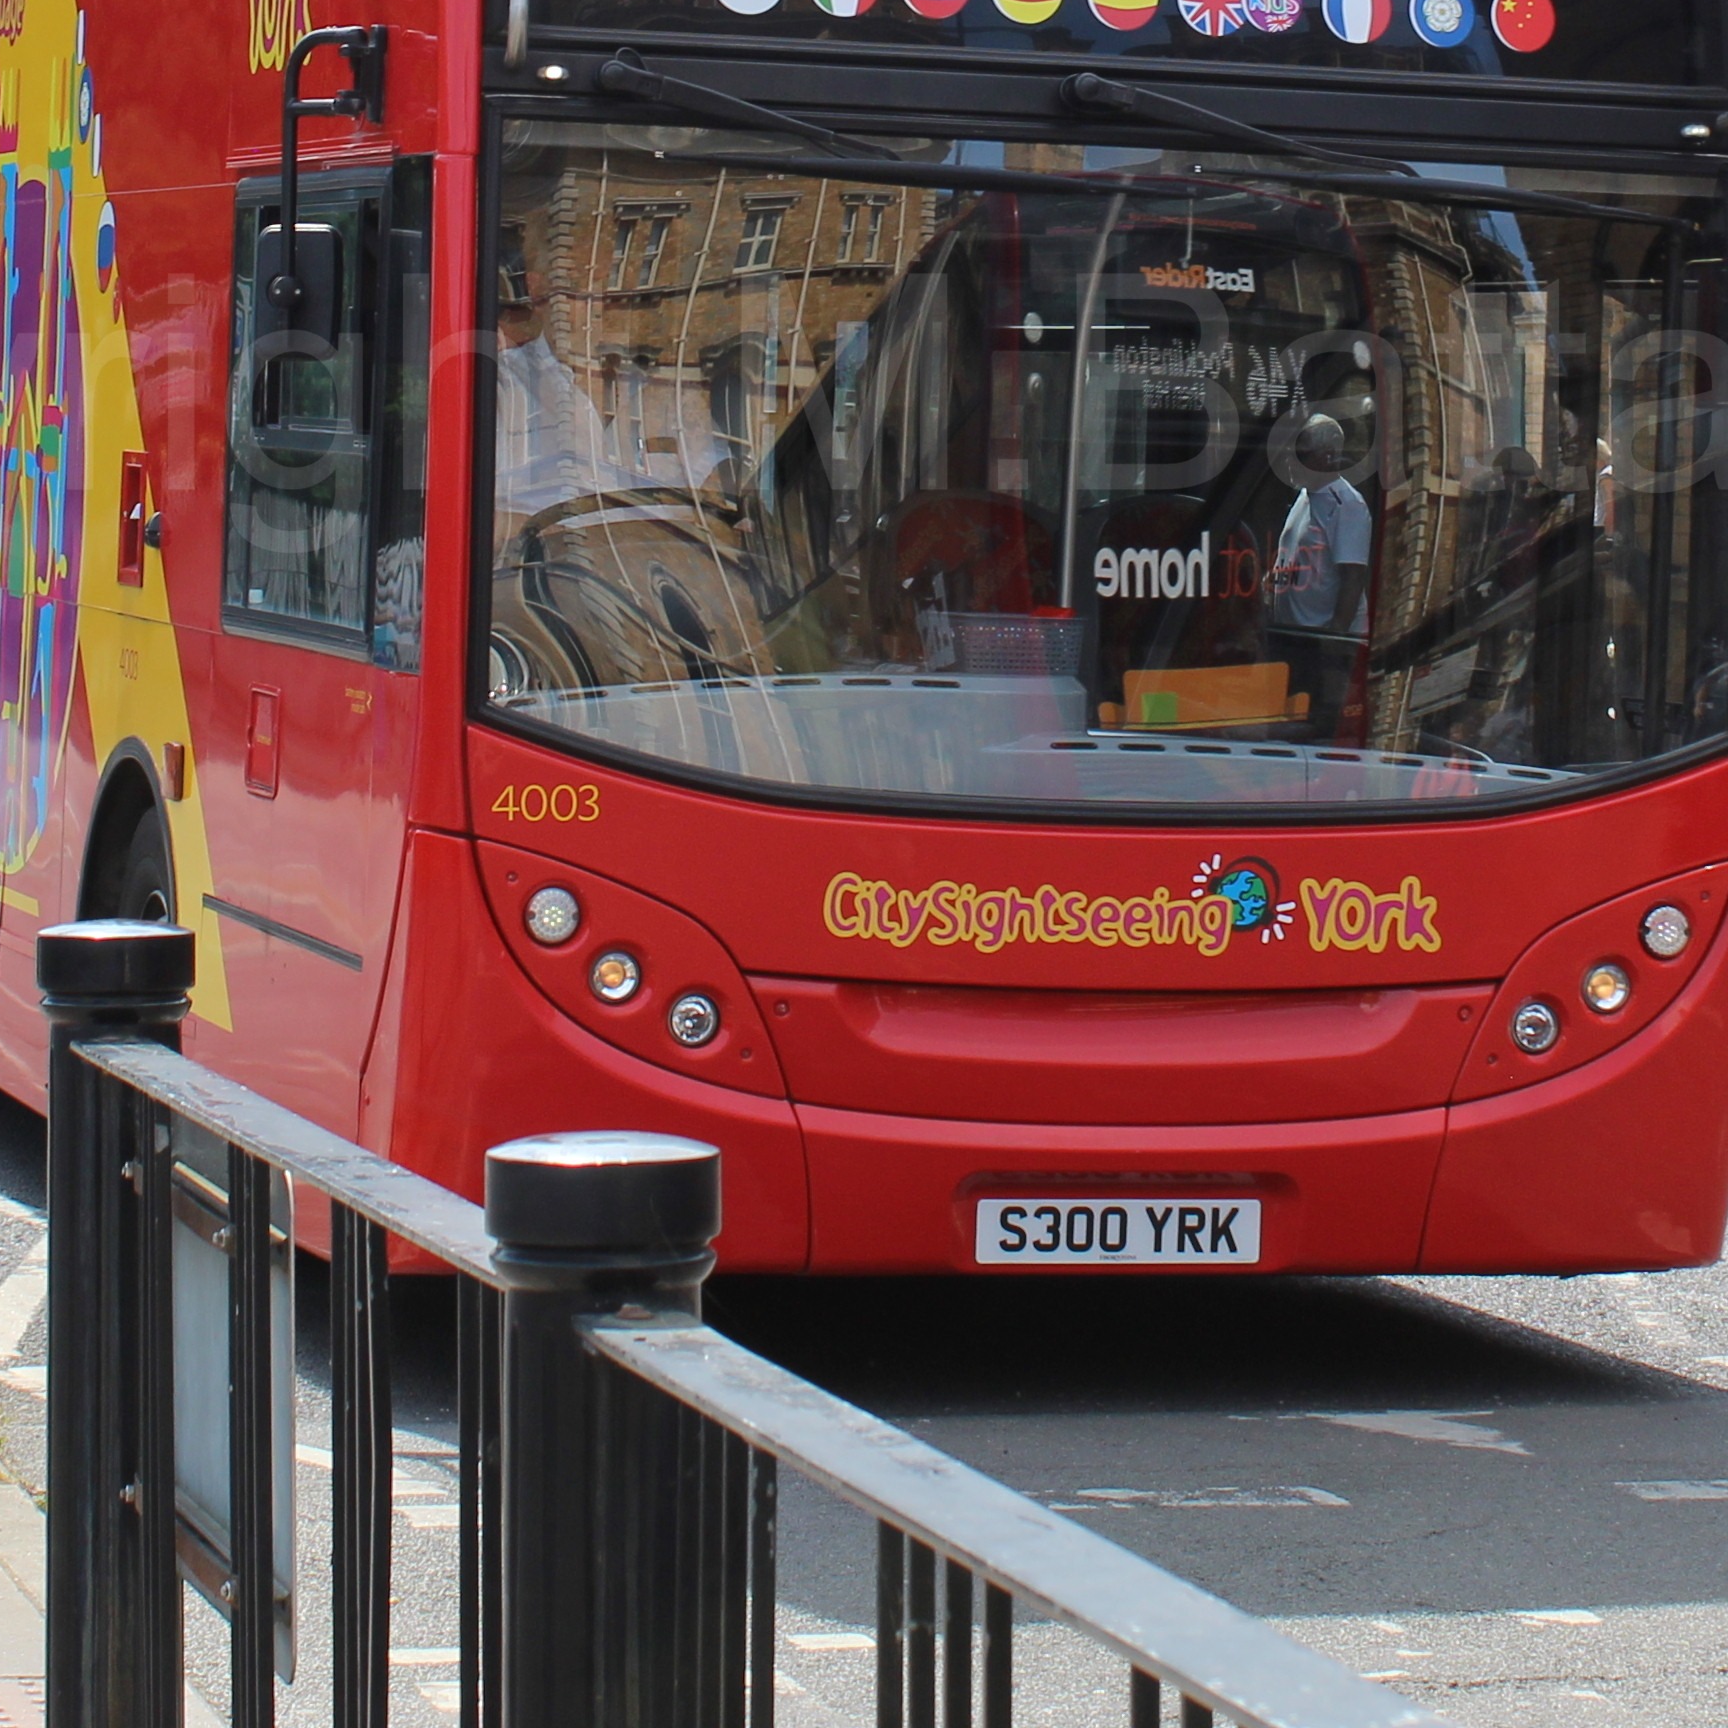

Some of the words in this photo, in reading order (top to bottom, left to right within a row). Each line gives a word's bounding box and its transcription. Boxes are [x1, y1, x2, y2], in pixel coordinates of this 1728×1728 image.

[491, 783, 600, 822] 4003
[1300, 876, 1442, 954] York
[998, 1205, 1129, 1253] S300
[1145, 1206, 1240, 1253] YRK
